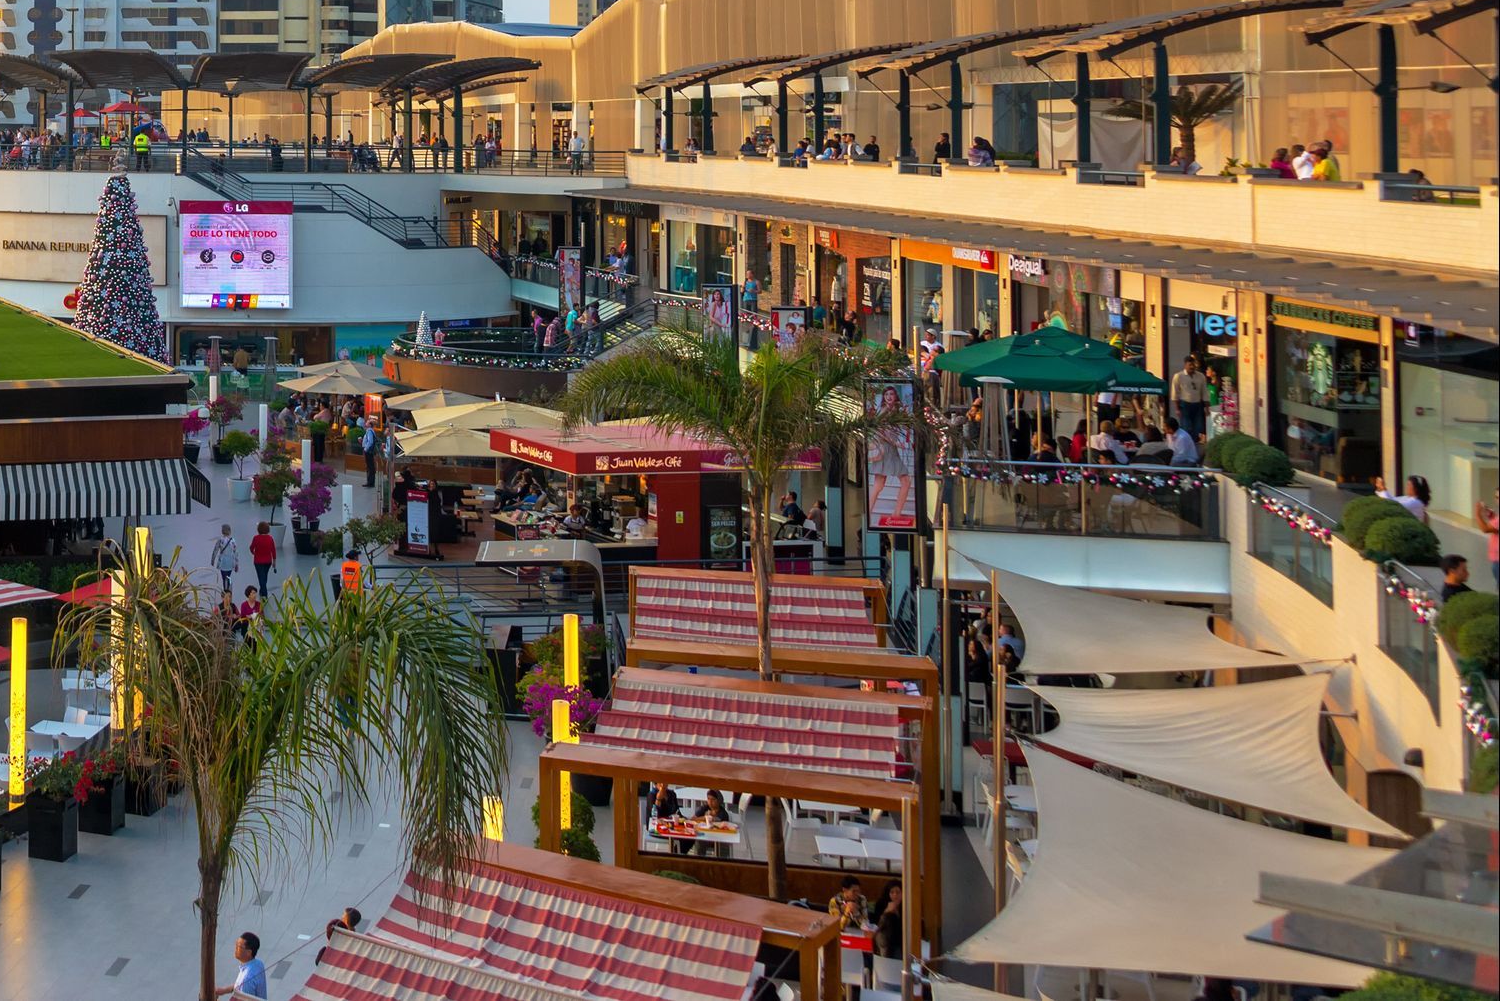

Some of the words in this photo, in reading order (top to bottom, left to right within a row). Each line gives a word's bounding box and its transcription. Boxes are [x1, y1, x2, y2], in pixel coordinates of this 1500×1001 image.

[235, 203, 249, 212] LG
[190, 230, 209, 238] QUE
[211, 230, 223, 238] LO
[225, 230, 251, 238] TIENE
[252, 230, 277, 238] TODO
[2, 240, 47, 252] BANANA
[50, 241, 96, 253] REPUBL
[1272, 301, 1332, 324] STARBUCKS
[1332, 310, 1375, 330] COFFEE
[610, 456, 634, 469] Juan
[633, 456, 664, 468] Valdez
[664, 455, 682, 468] Café
